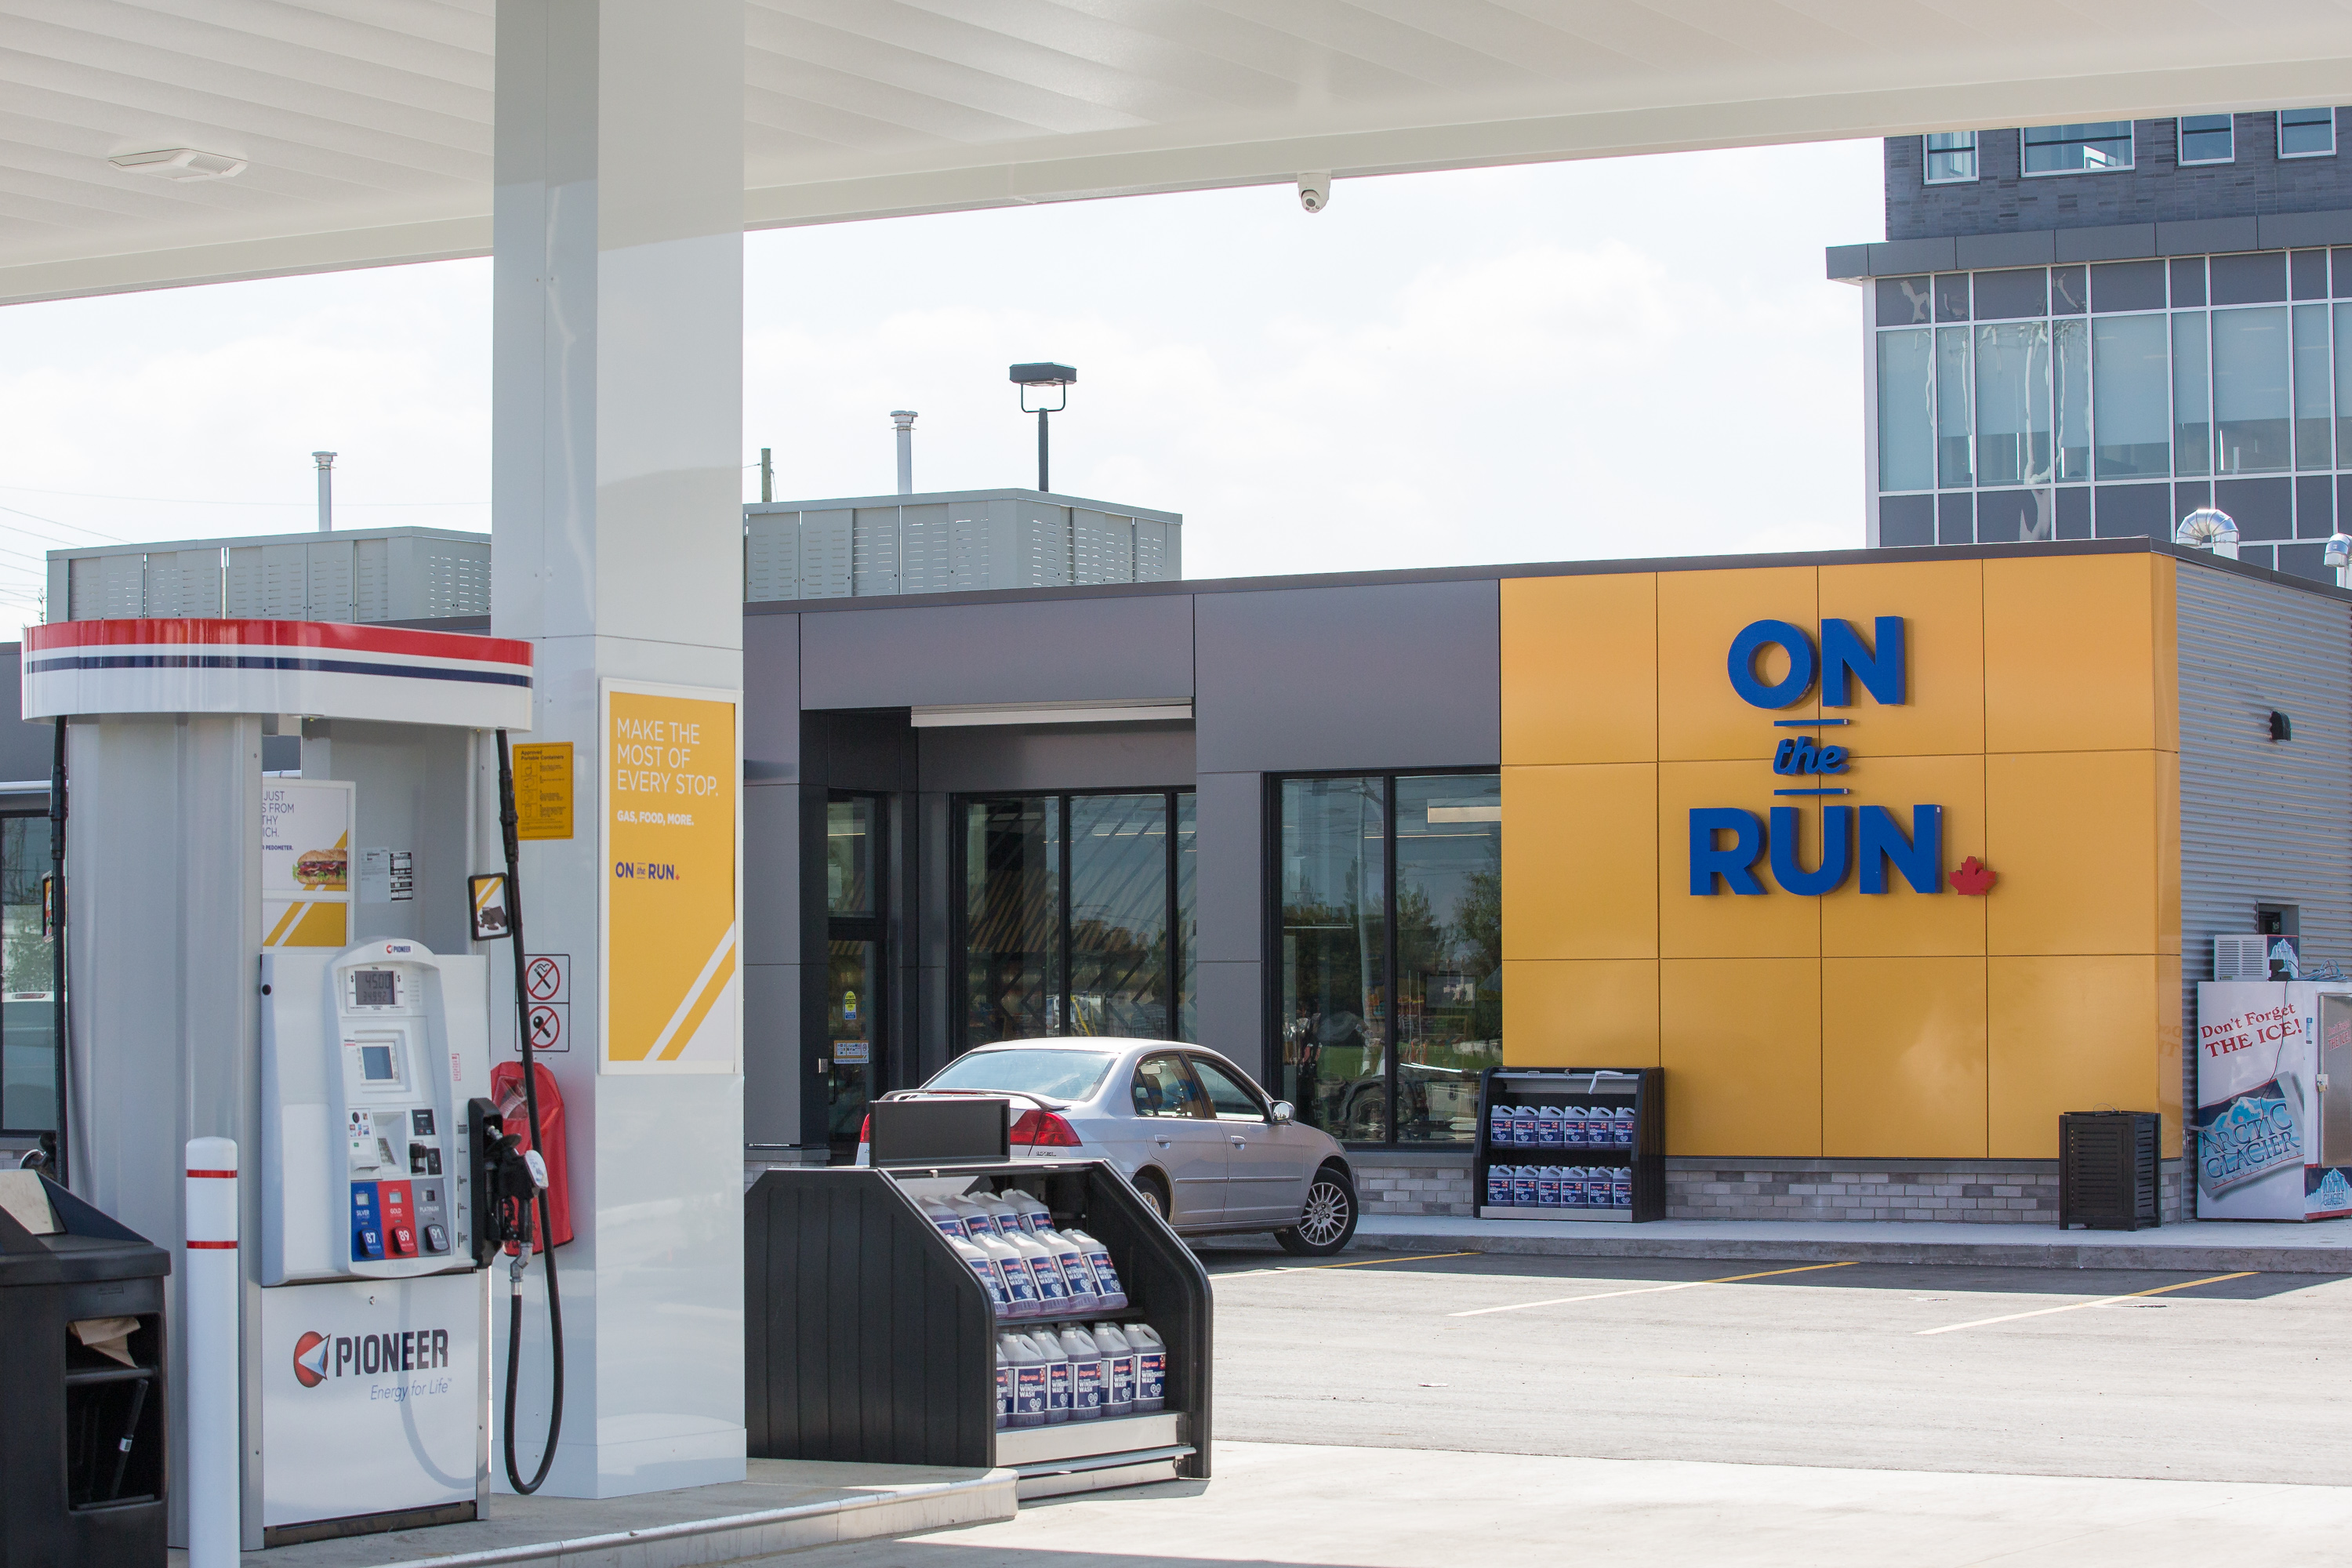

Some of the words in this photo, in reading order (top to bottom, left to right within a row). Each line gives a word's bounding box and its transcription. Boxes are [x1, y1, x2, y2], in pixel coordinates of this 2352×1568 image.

[1727, 615, 1906, 710] ON
[617, 717, 664, 742] MAKE
[669, 721, 700, 744] THE
[617, 743, 663, 767] MOST
[669, 747, 691, 769] OF
[1773, 735, 1850, 775] the
[263, 790, 285, 801] JUST
[618, 769, 671, 793] EVERY
[676, 773, 719, 797] STOP.
[269, 803, 295, 813] FROM
[617, 810, 637, 824] GAS,
[639, 811, 666, 826] FOOD,
[667, 813, 695, 826] MORE.
[1689, 804, 1943, 895] RUN
[615, 861, 634, 878] ON
[2200, 1018, 2242, 1039] Don't
[2244, 1003, 2296, 1026] Forget
[2205, 1033, 2253, 1058] THE
[2256, 1018, 2303, 1044] ICE!
[2201, 1102, 2292, 1159] ARCTIC
[2205, 1131, 2300, 1178] GLACIER
[365, 1232, 376, 1243] 87
[398, 1230, 410, 1241] 89
[431, 1228, 443, 1239] 91
[336, 1328, 448, 1377] PIONEER
[370, 1384, 408, 1402] Energy
[411, 1380, 426, 1396] for
